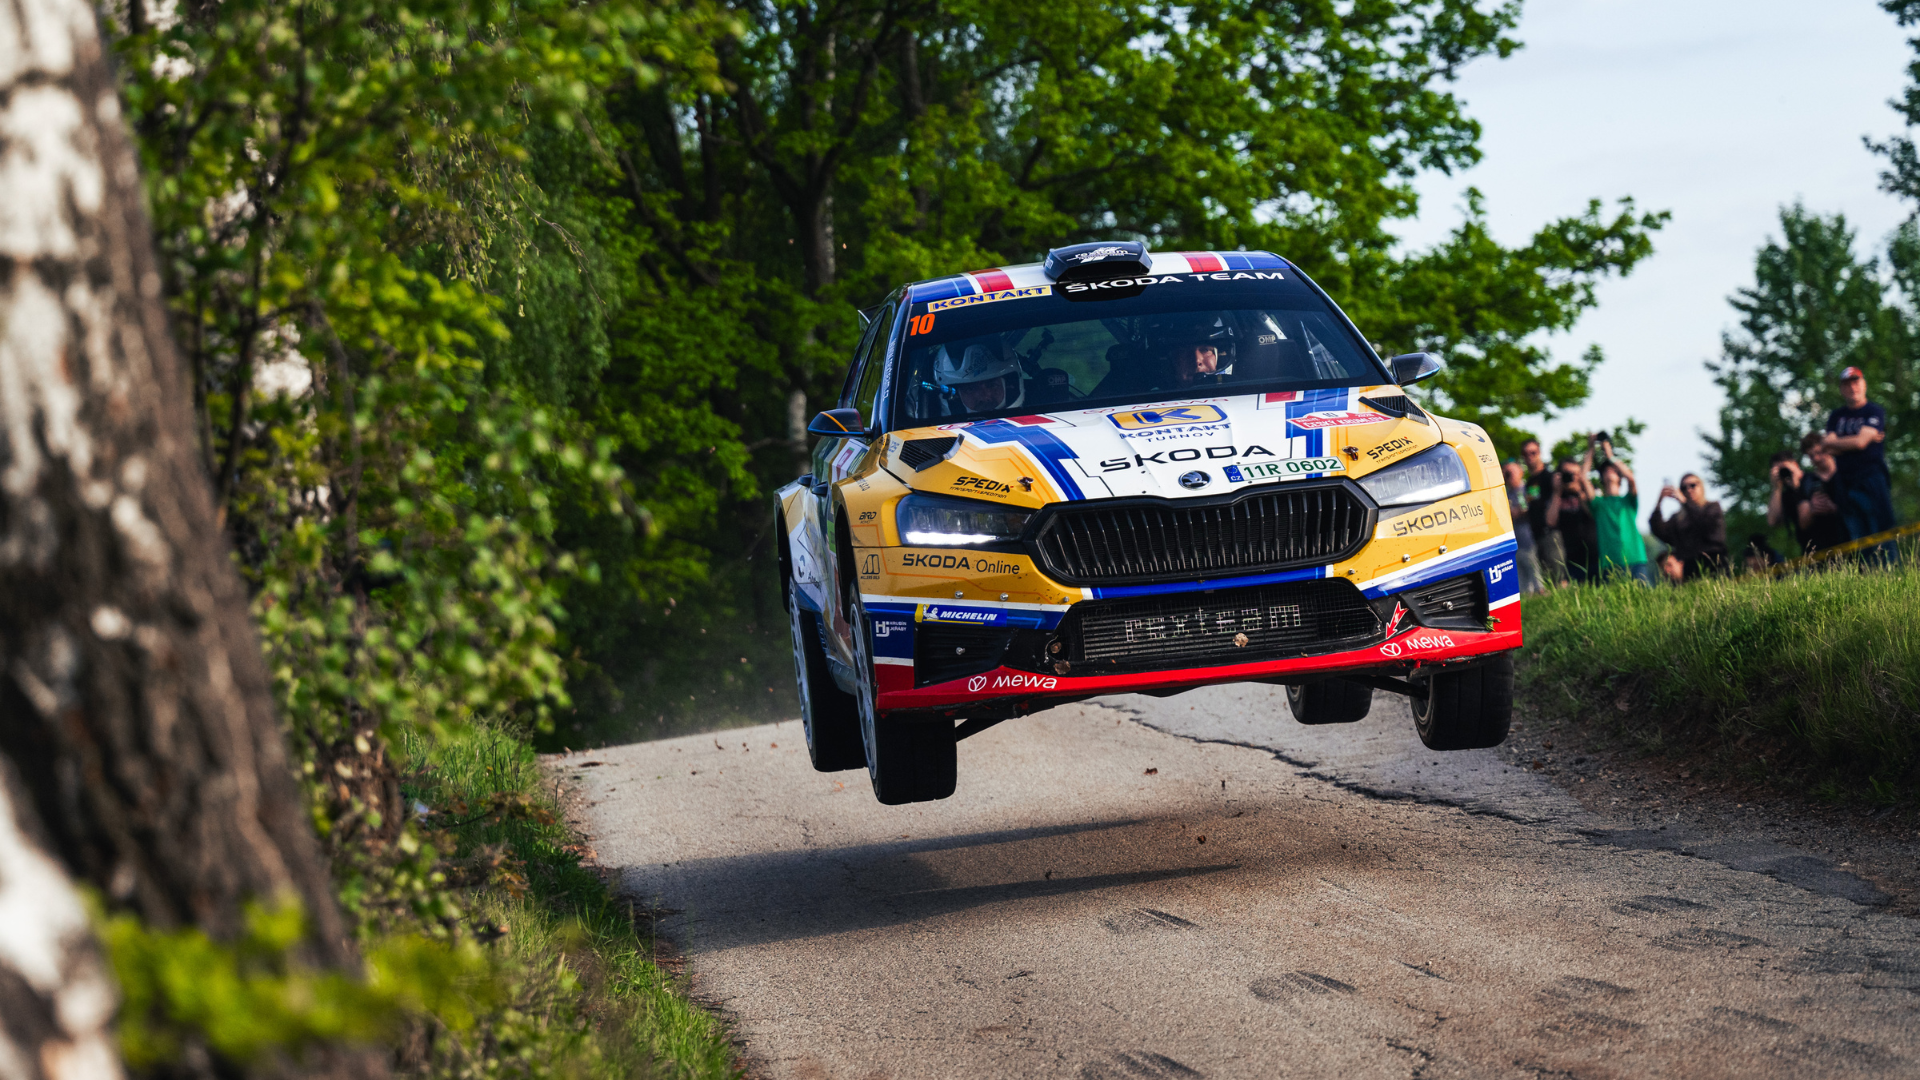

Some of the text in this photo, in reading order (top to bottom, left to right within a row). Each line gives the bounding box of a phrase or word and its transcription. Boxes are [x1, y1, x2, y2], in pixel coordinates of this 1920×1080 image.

[1189, 272, 1284, 281] TEAM
[932, 287, 1046, 310] KONTAKT
[910, 313, 935, 336] 10
[1258, 335, 1276, 344] OMP
[1119, 423, 1231, 439] KONTAKT
[1145, 432, 1214, 443] TURNOV
[1366, 436, 1413, 459] SPEDIX
[1244, 459, 1341, 478] 11R 0602
[953, 476, 1014, 493] SPEDIX
[1461, 504, 1484, 519] Plus
[976, 559, 1020, 575] Online
[940, 611, 997, 621] MICHELIN
